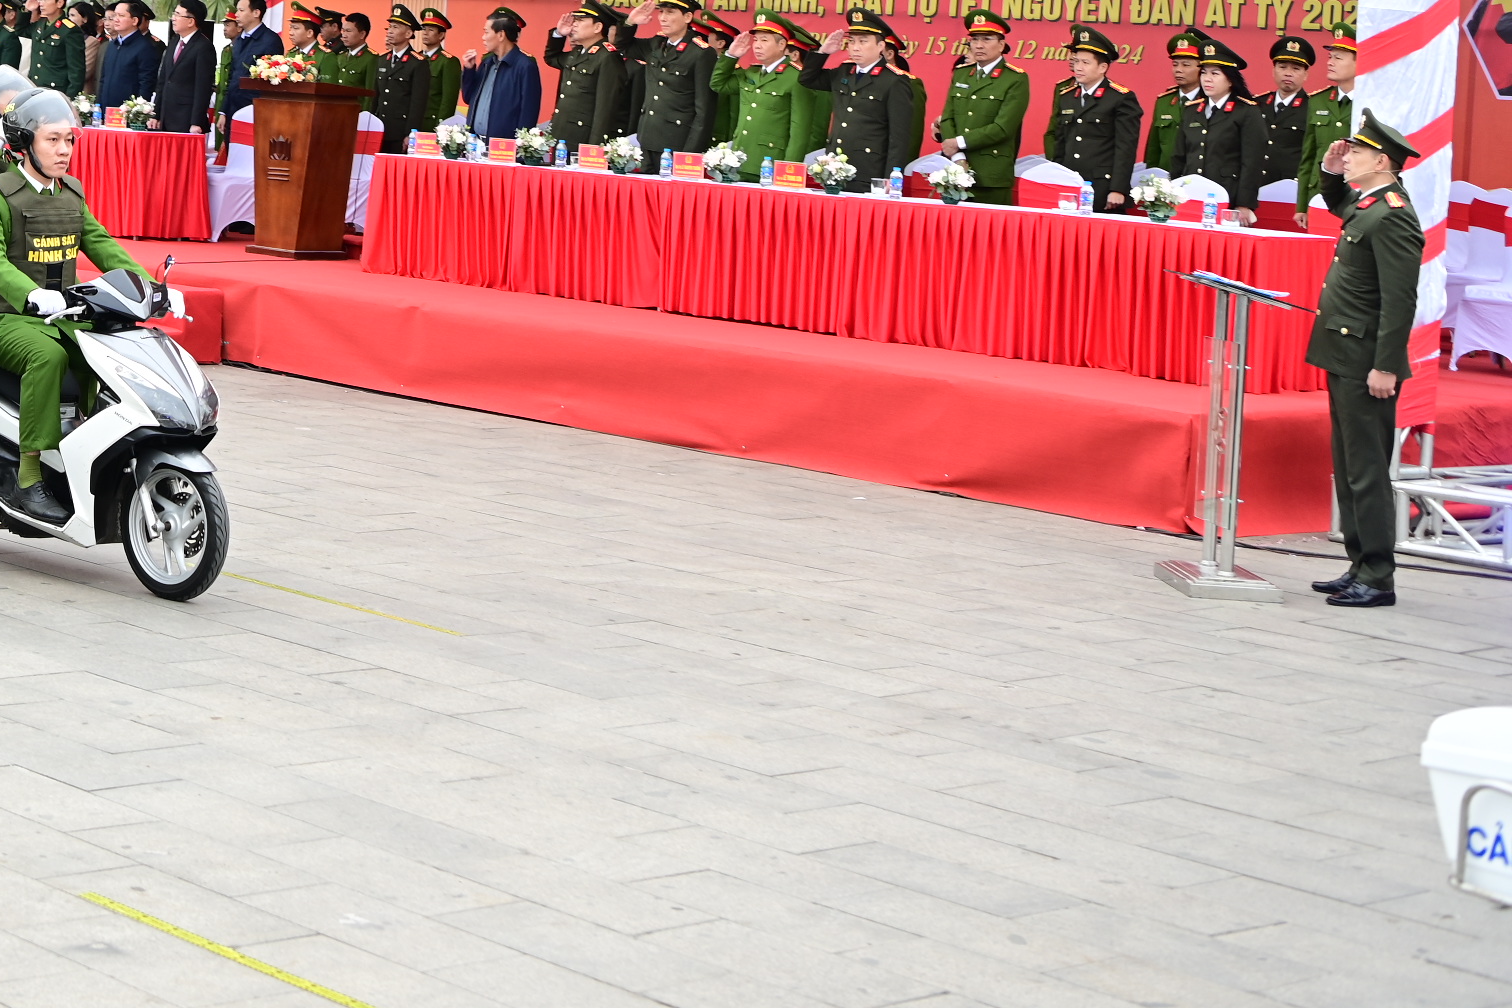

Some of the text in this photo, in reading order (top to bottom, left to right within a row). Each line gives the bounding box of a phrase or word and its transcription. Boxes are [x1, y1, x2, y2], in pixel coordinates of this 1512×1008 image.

[924, 36, 948, 56] 15
[1013, 39, 1038, 59] 12
[1040, 41, 1069, 61] nă
[1115, 44, 1145, 65] 24
[27, 248, 63, 263] HÌNH
[1466, 820, 1510, 866] CẢ
